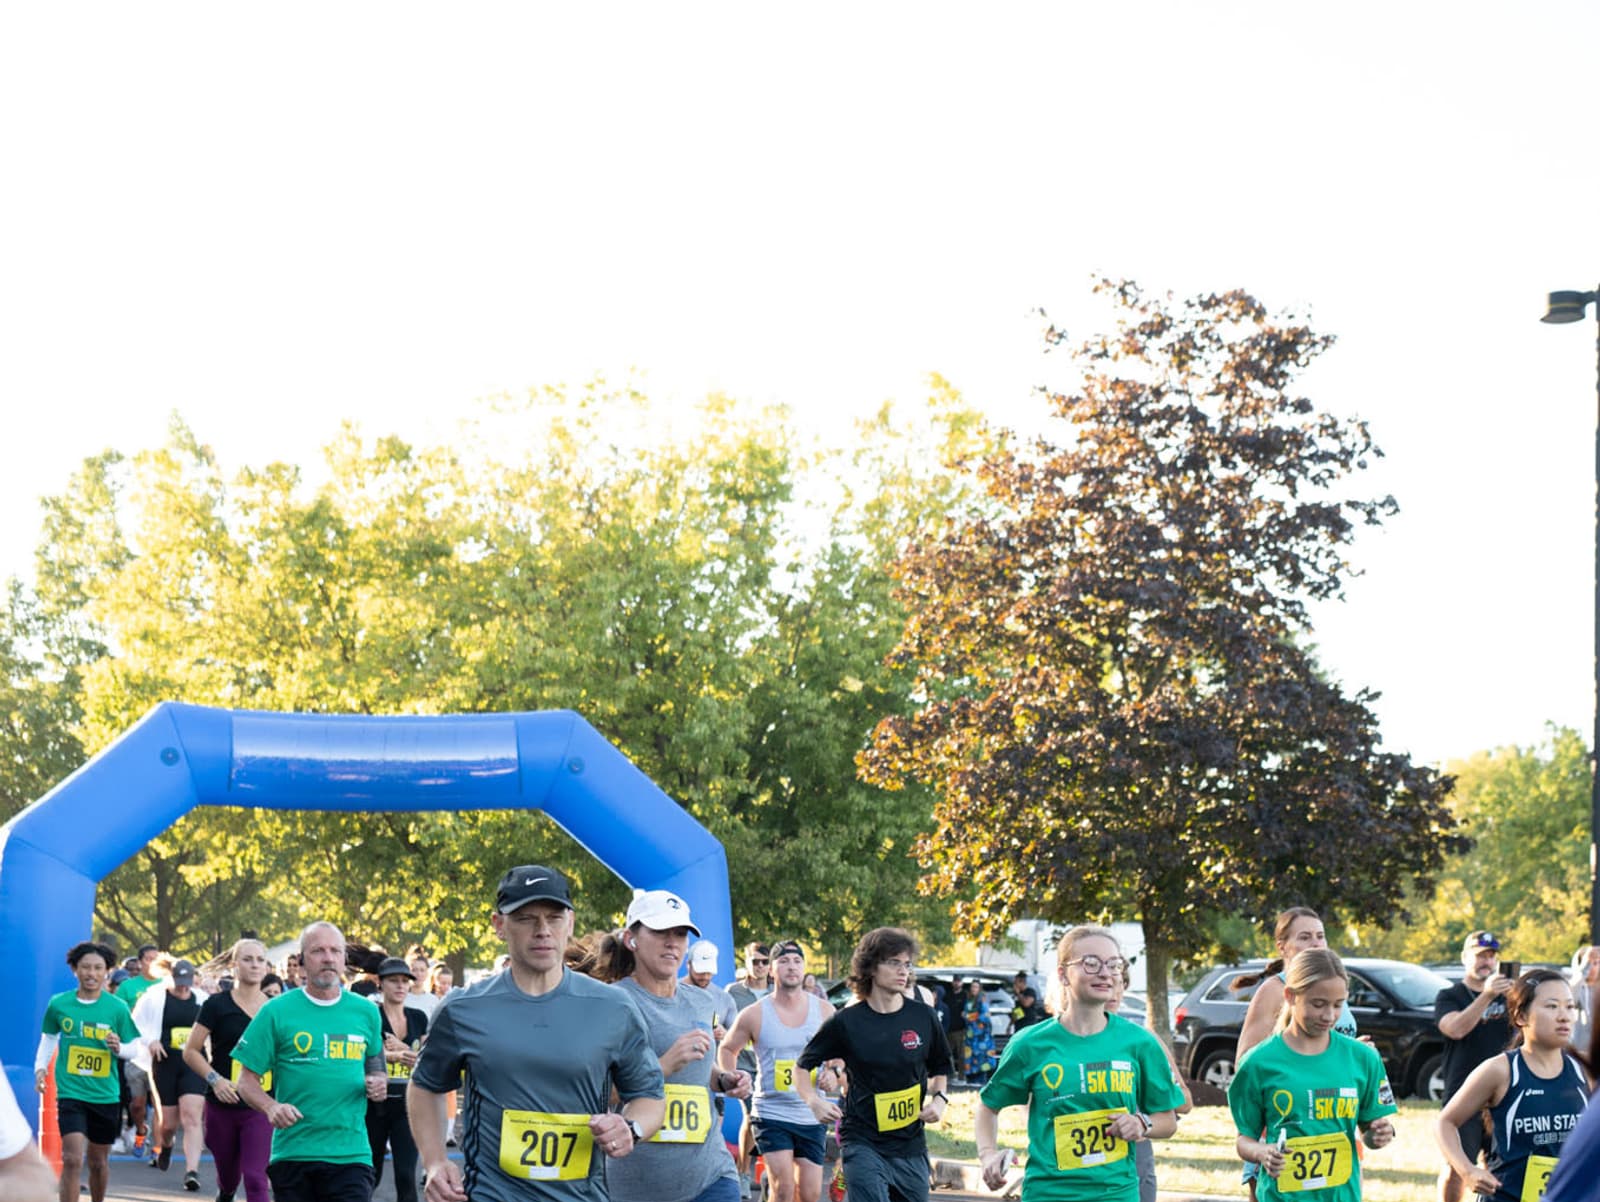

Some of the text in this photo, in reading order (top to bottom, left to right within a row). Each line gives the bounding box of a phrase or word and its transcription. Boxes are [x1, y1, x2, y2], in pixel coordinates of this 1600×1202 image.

[329, 1041, 344, 1059] 5K
[76, 1054, 102, 1072] 290
[1087, 1071, 1108, 1094] 5K
[661, 1100, 699, 1131] 06
[888, 1098, 914, 1122] 405
[1315, 1097, 1334, 1120] 5K
[1515, 1115, 1551, 1134] PENN
[520, 1130, 578, 1168] 207
[1071, 1123, 1116, 1157] 325
[1292, 1148, 1337, 1180] 327
